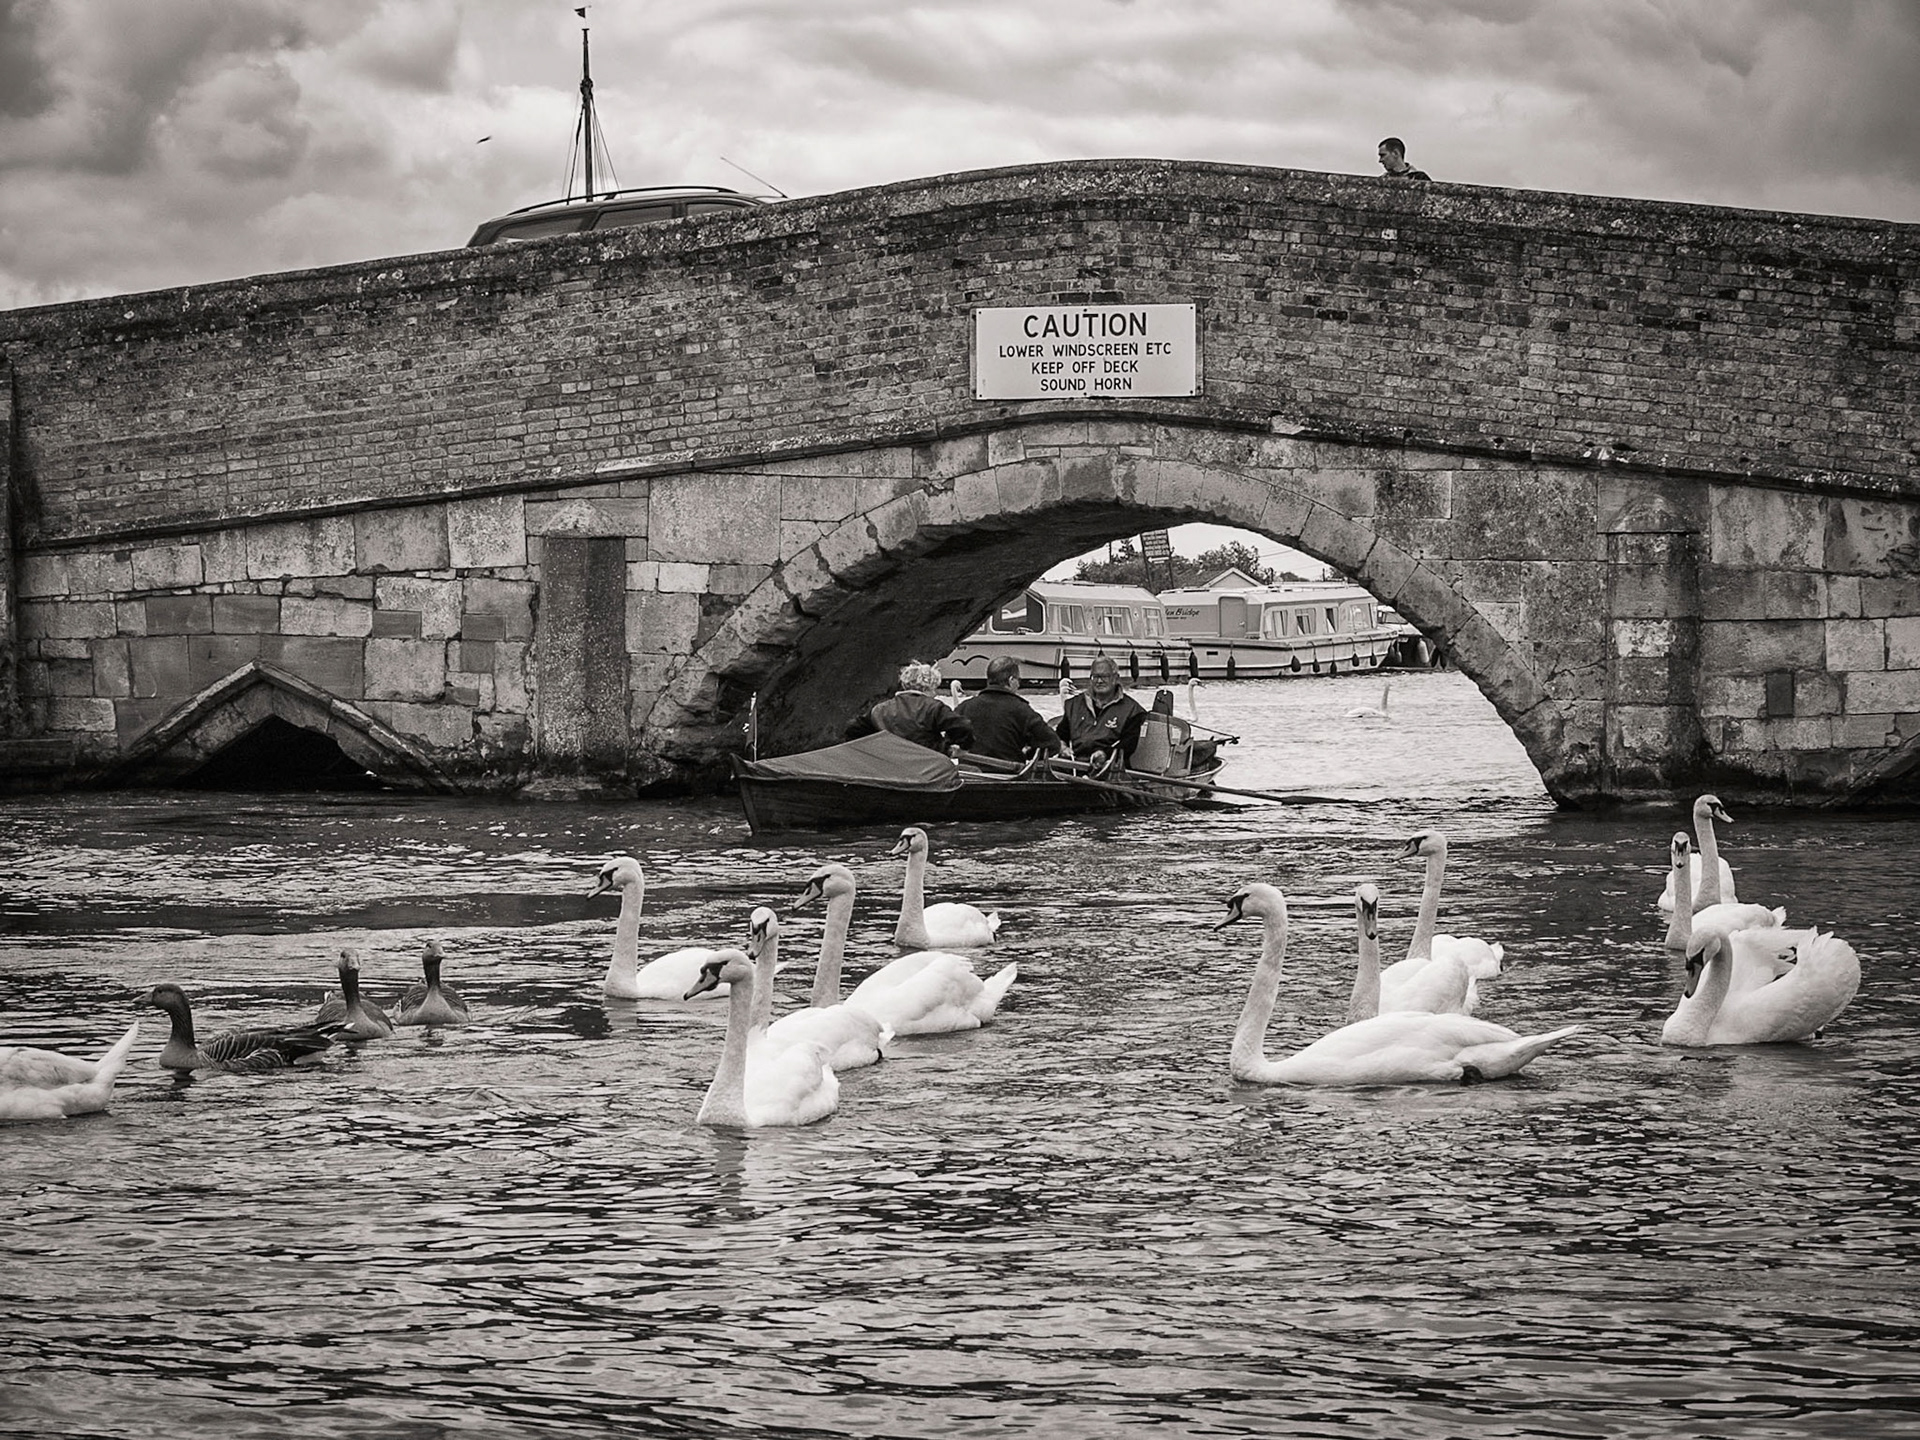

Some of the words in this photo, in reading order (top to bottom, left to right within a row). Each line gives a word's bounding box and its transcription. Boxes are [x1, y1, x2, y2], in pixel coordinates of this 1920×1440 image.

[1023, 312, 1147, 338] CAUTION
[999, 345, 1044, 358] LOWER
[1053, 343, 1138, 357] WINDSCREEN
[1146, 342, 1172, 355] ETC
[1031, 361, 1064, 374] KEEP
[1072, 361, 1095, 374] OFF
[1104, 360, 1139, 373] DECK
[1041, 378, 1086, 391] SOUND
[1094, 377, 1132, 390] HORN
[1176, 608, 1200, 617] Bridge
